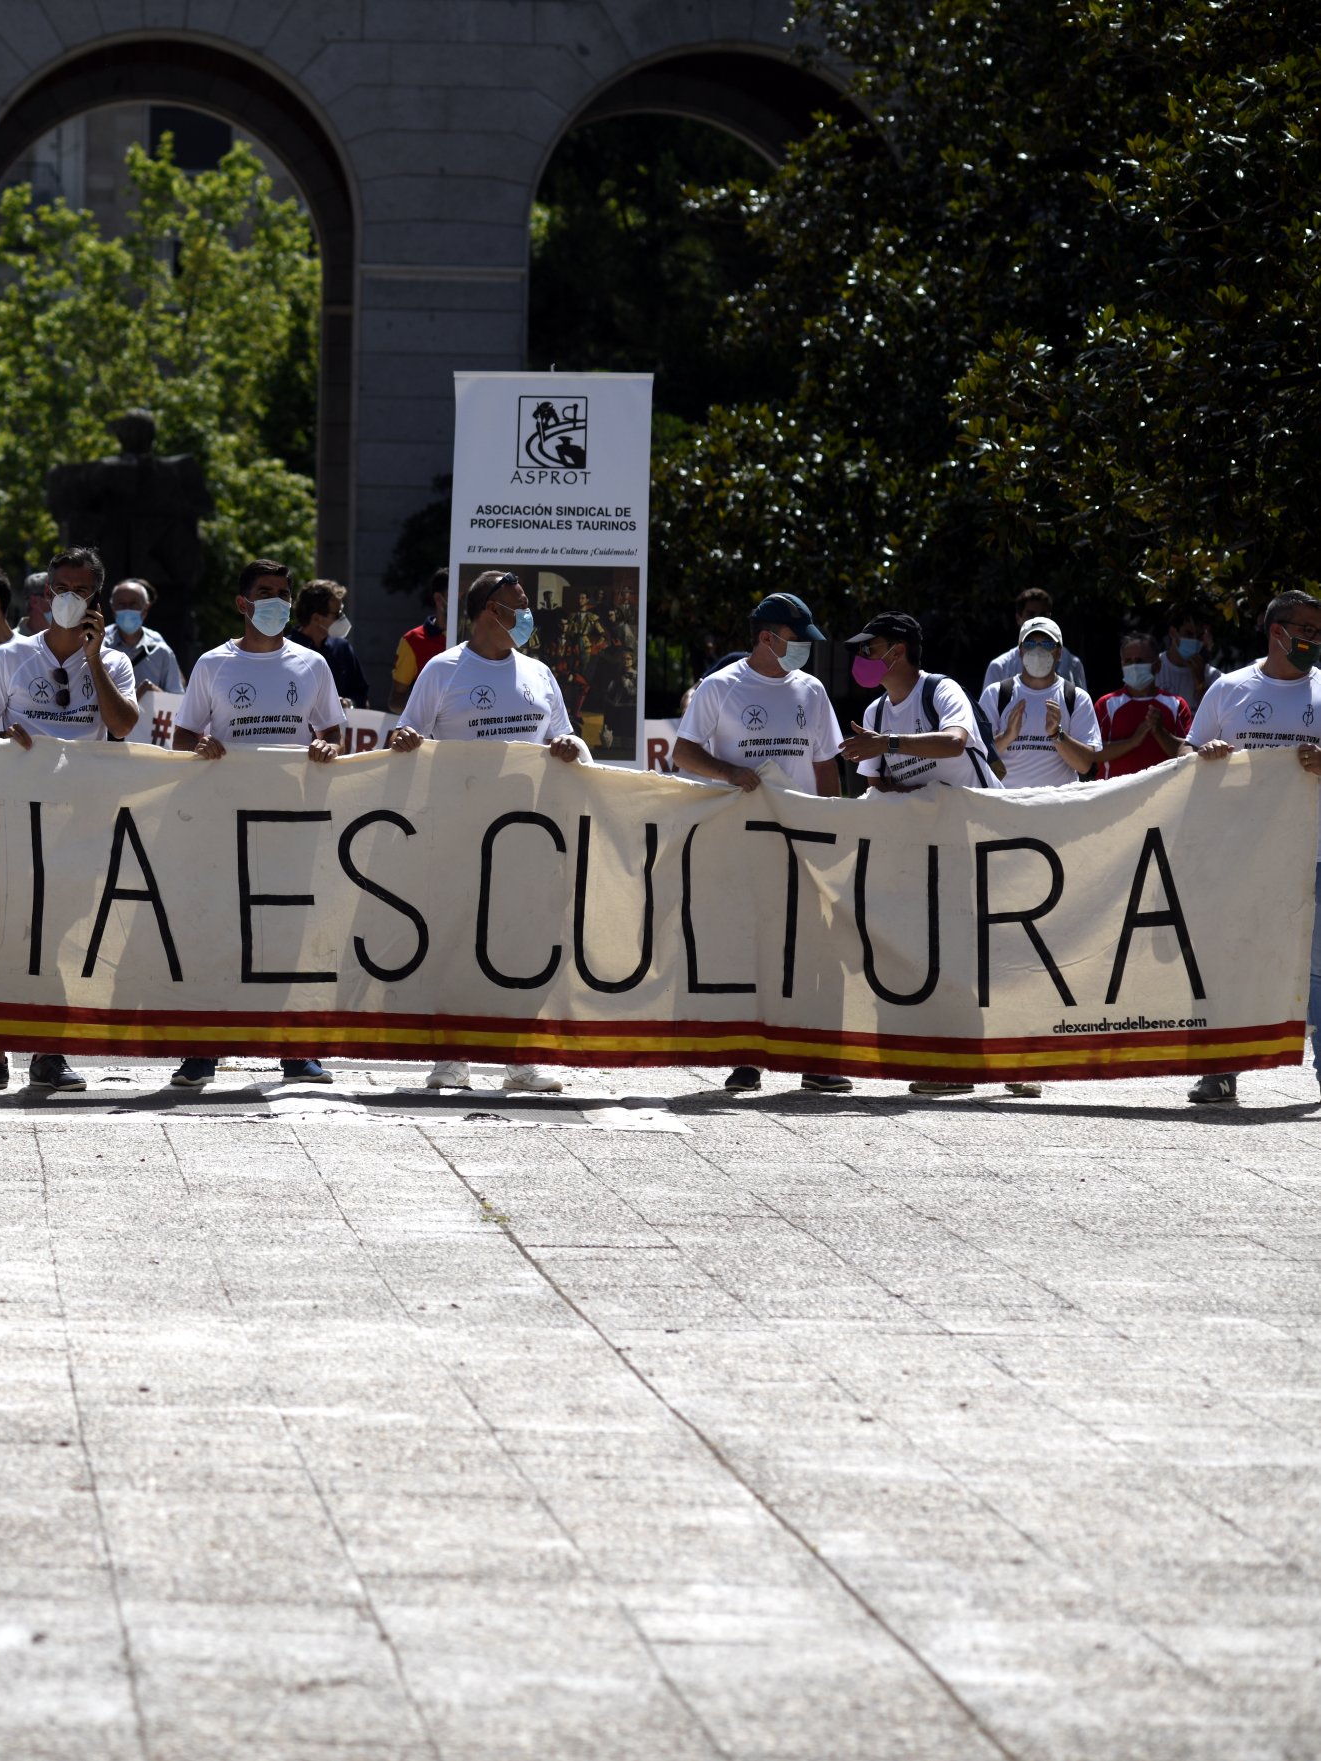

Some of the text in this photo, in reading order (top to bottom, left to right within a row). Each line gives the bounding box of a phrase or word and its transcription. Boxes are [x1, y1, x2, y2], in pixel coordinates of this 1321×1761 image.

[510, 470, 591, 485] ASPROT
[476, 503, 632, 517] ASOCIACIÓN SINDICAL DE
[470, 518, 637, 531] PROFESIONALES TAURINOS
[467, 545, 476, 553] El
[478, 545, 498, 553] Toreo
[499, 546, 515, 554] está
[516, 546, 539, 555] dentro
[541, 547, 550, 555] de
[551, 547, 559, 555] la
[560, 547, 589, 556] Cultura
[261, 714, 281, 723] SOMOS
[468, 719, 479, 727] LOS
[480, 716, 503, 726] TOREROS
[504, 714, 523, 723] SOMOS
[1236, 732, 1320, 744] LOS TOREROS SOMOS CULTURA
[237, 809, 429, 983] ES
[475, 811, 1206, 1008] CULTURA
[1052, 1016, 1207, 1033] alexandradelbene.com
